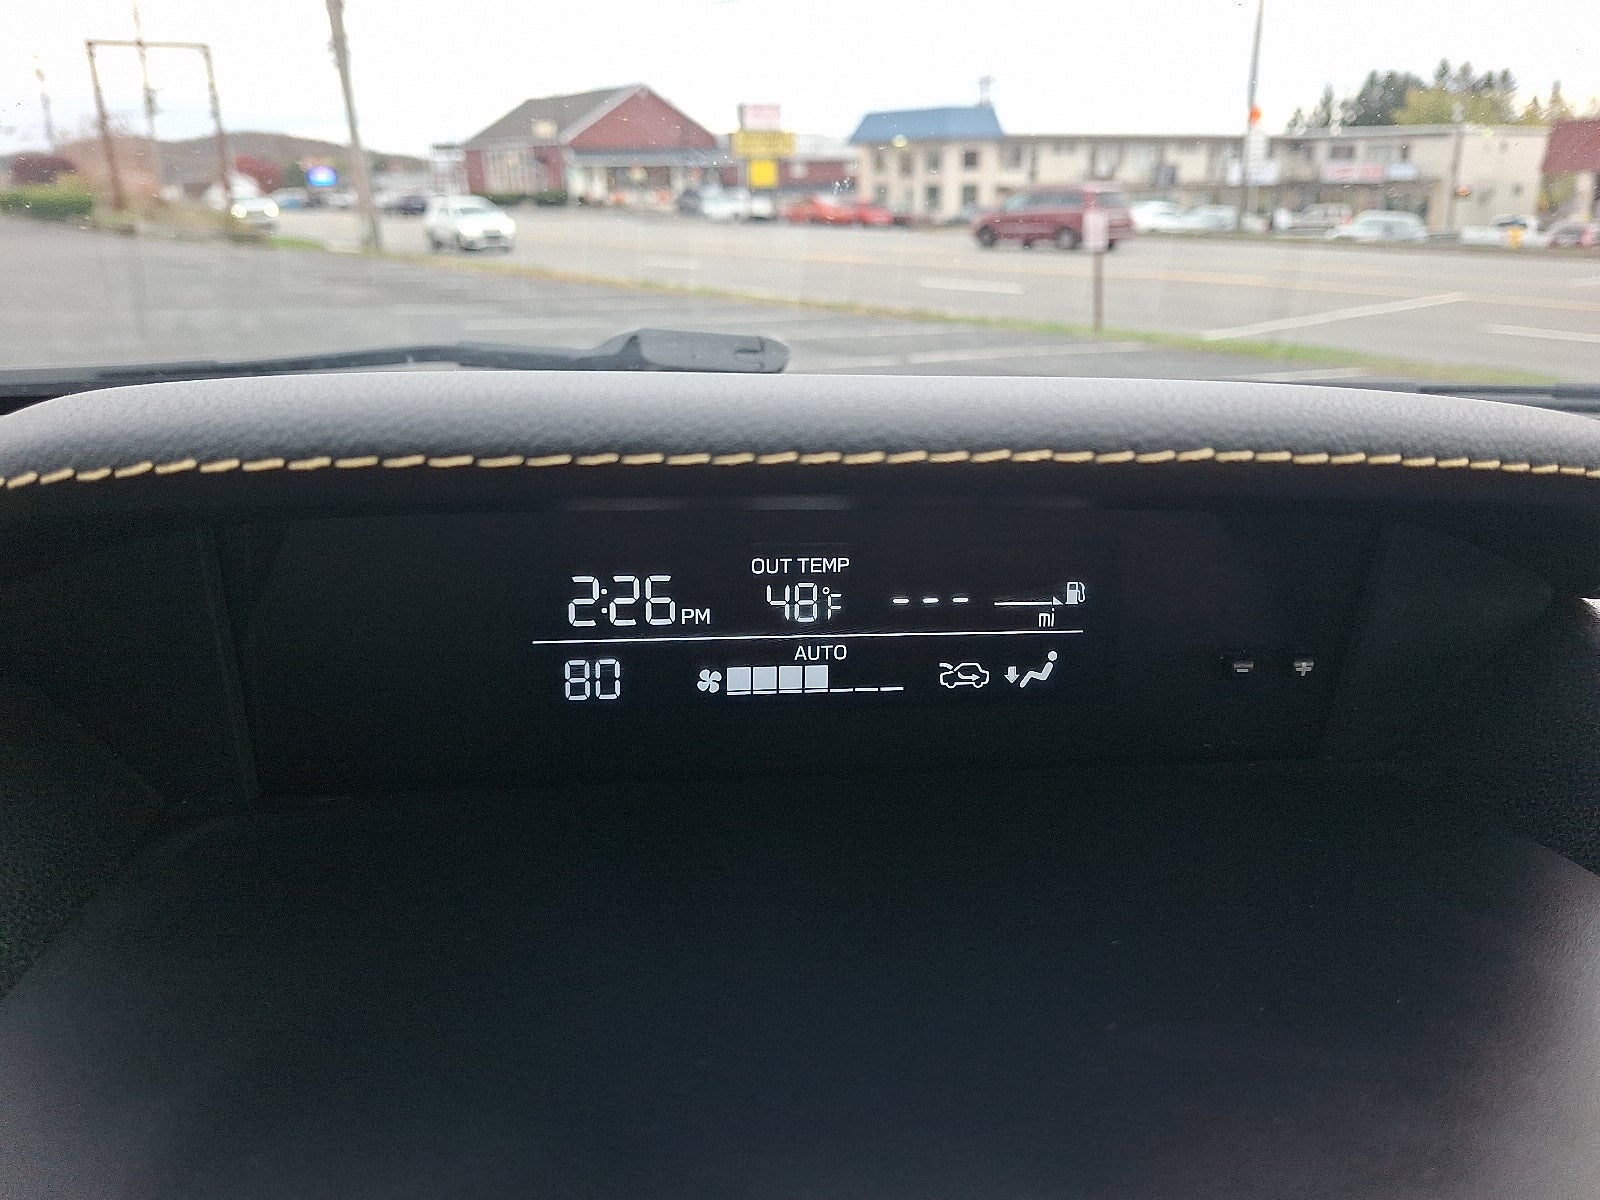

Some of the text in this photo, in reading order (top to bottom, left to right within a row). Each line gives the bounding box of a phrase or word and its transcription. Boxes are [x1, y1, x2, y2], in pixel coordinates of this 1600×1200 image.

[751, 557, 850, 575] OUT TEMP
[567, 574, 711, 627] 2:26 PM
[1038, 607, 1055, 628] mi
[793, 644, 848, 661] AUTO
[564, 658, 621, 701] 80
